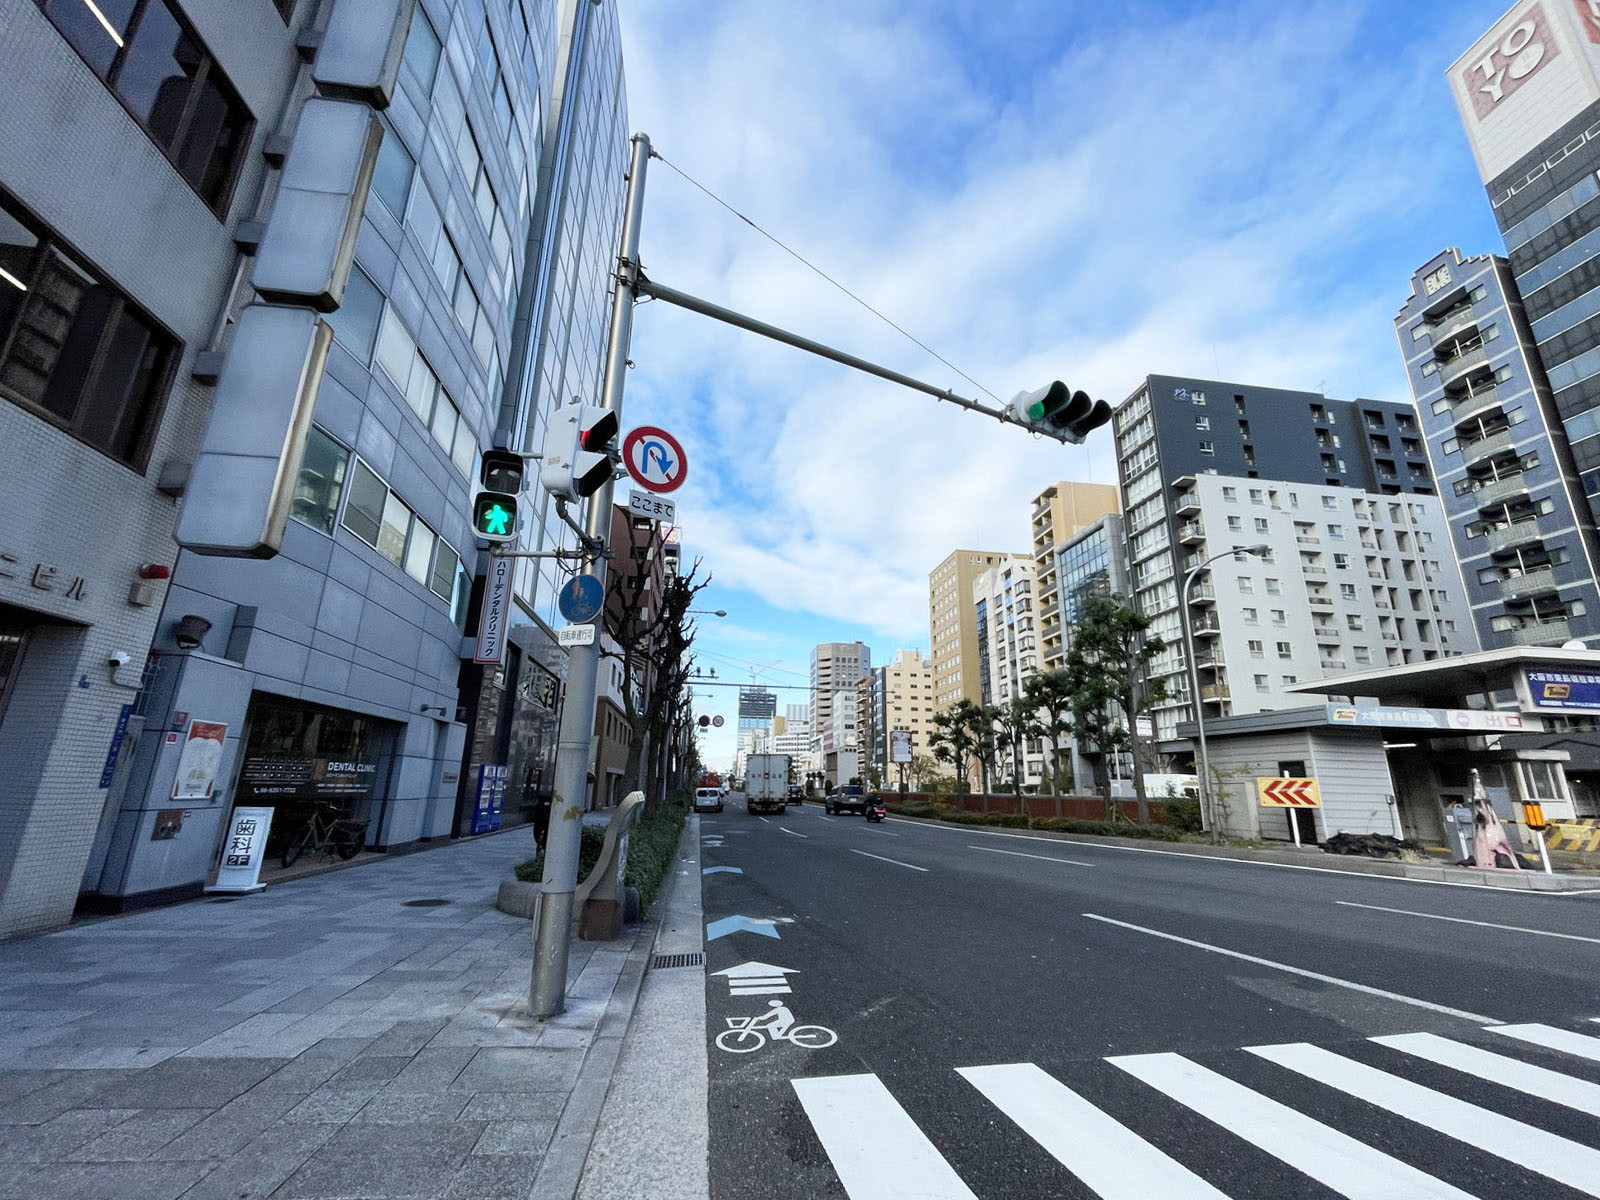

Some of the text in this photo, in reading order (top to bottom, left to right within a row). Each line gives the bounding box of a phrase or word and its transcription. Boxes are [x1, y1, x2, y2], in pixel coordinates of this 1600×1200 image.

[632, 496, 674, 517] ここまで
[485, 561, 506, 657] ハローデンタルクリニック
[560, 629, 593, 641] 自転車通行可
[1486, 715, 1523, 728] 出口
[327, 761, 376, 773] DENTAL CLINIC
[230, 819, 257, 854] 歯科
[228, 855, 249, 866] 2F
